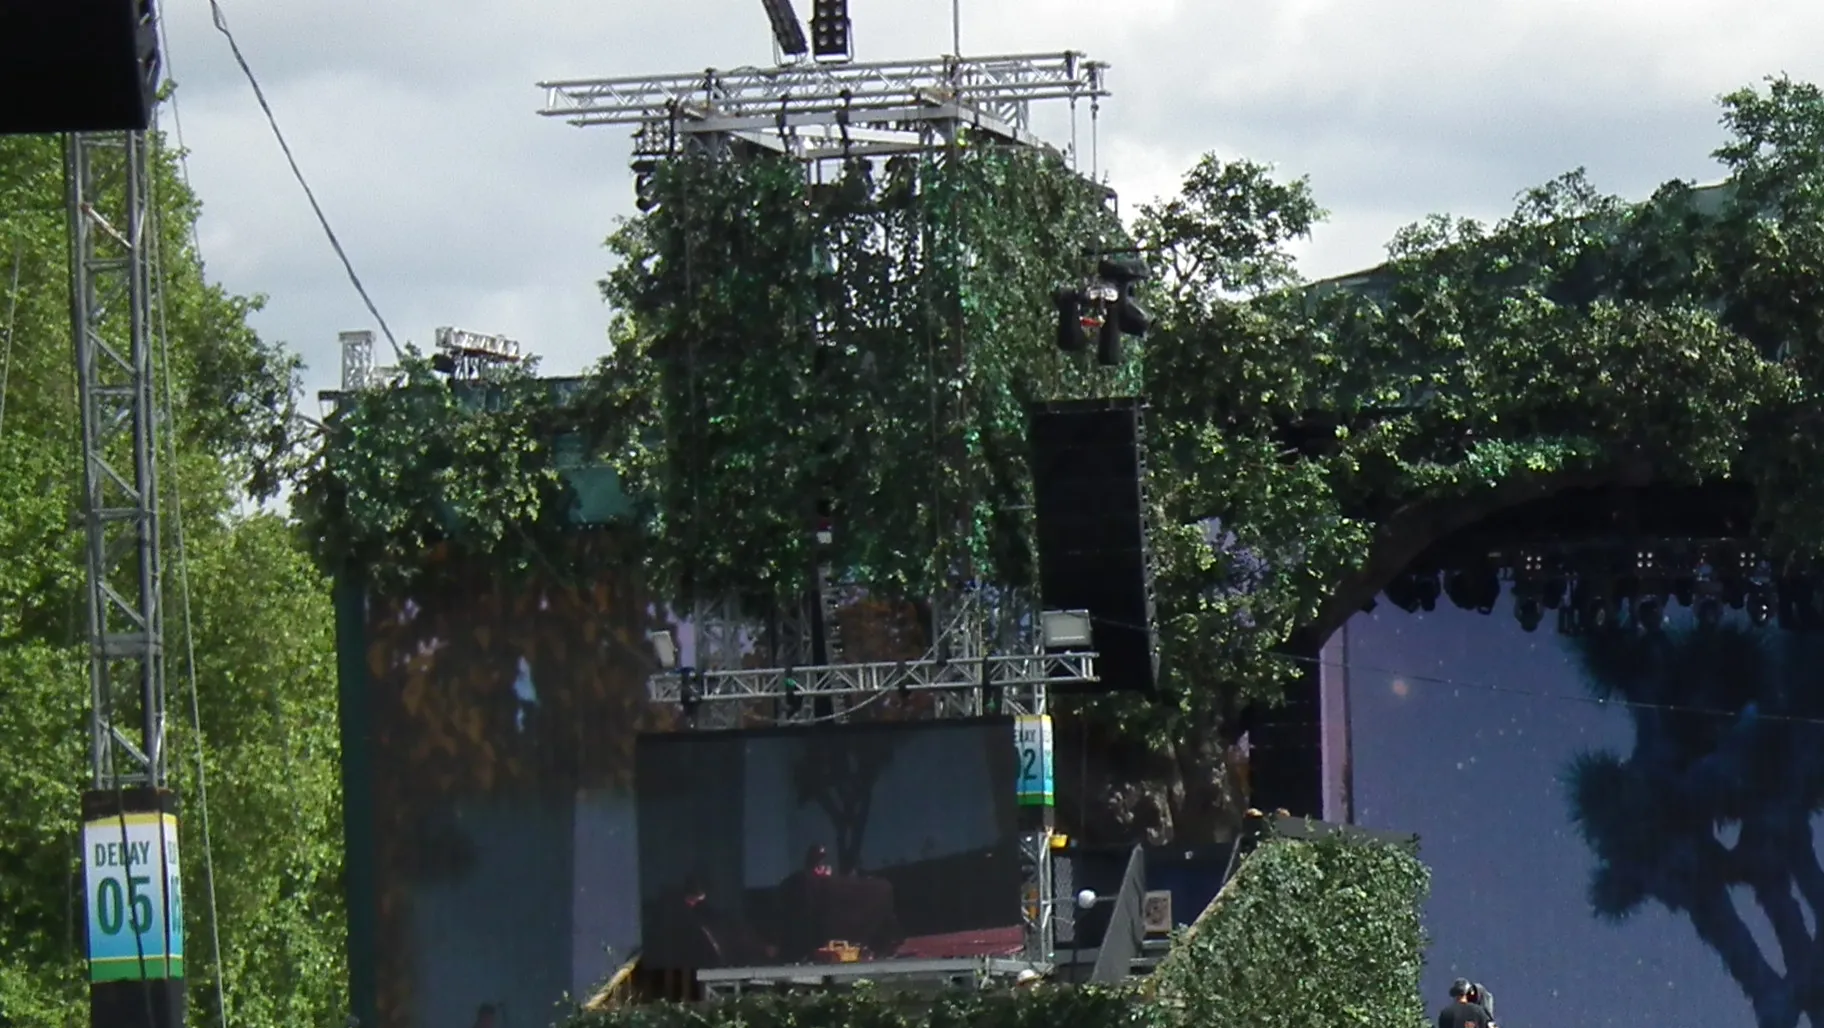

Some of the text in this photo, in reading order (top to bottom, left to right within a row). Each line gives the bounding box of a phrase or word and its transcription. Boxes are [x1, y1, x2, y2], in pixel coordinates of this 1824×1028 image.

[1013, 729, 1036, 743] ELAY
[95, 840, 150, 867] DELAY
[97, 876, 153, 935] 05
